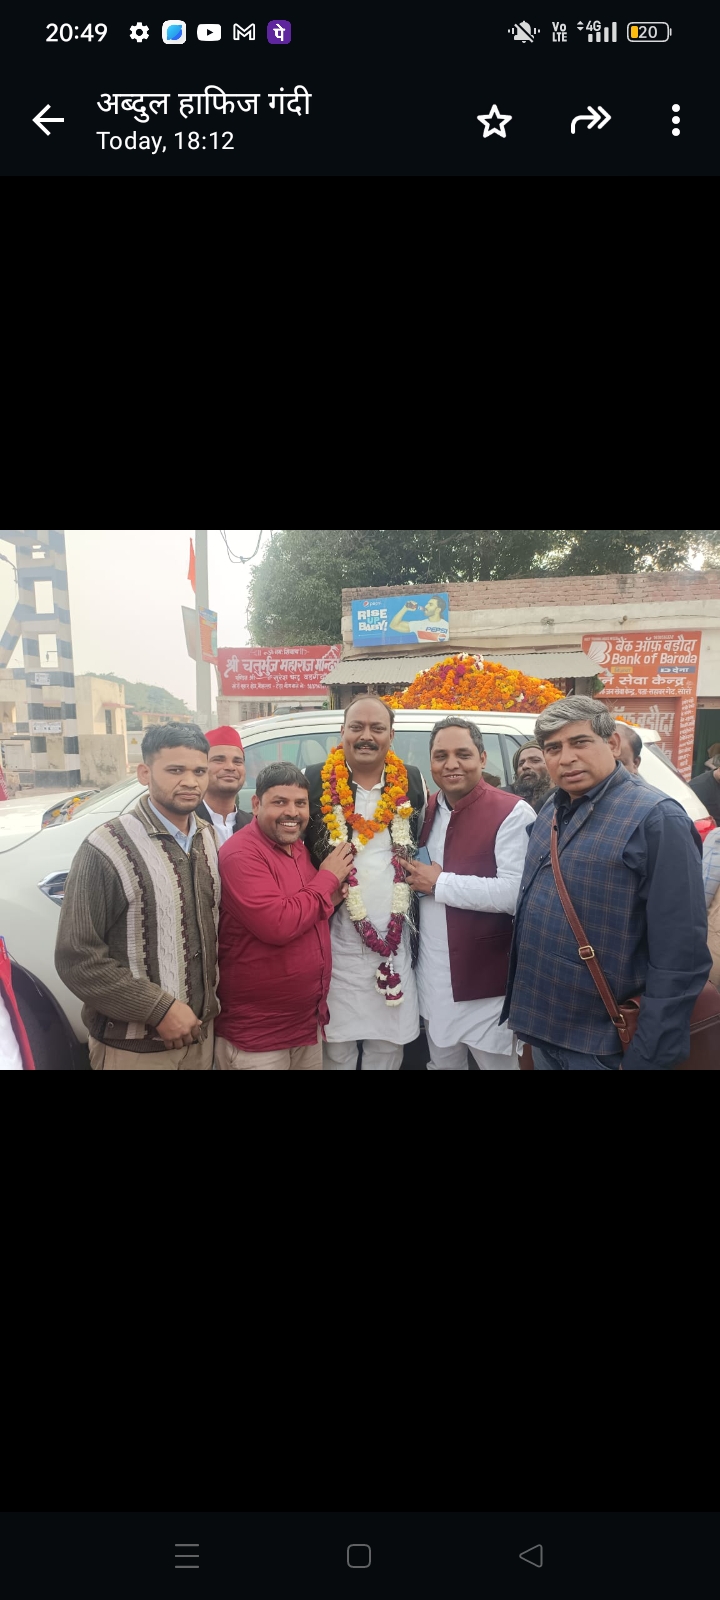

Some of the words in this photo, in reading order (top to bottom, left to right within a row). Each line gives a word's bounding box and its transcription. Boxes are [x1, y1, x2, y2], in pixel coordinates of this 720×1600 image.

[45, 22, 108, 42] 20:49
[552, 21, 567, 32] Vo
[585, 20, 602, 31] 4G
[552, 32, 567, 42] LTE
[638, 26, 658, 39] 20
[96, 93, 171, 123] अब्दुल
[177, 85, 261, 119] हाफिज
[267, 85, 312, 116] गंदी
[96, 130, 167, 155] Today,
[174, 131, 235, 150] 18:12
[357, 608, 388, 620] RISE
[367, 616, 380, 624] UP
[425, 626, 448, 634] PEPSI
[615, 637, 633, 652] बैंक
[663, 635, 697, 654] बड़ौदा
[611, 652, 641, 665] Bank
[643, 652, 658, 664] of
[660, 652, 698, 664] Baroda
[224, 655, 239, 678] श्री
[280, 658, 315, 674] महाराज
[619, 674, 648, 685] सेवा
[652, 674, 687, 687] केन्द्र
